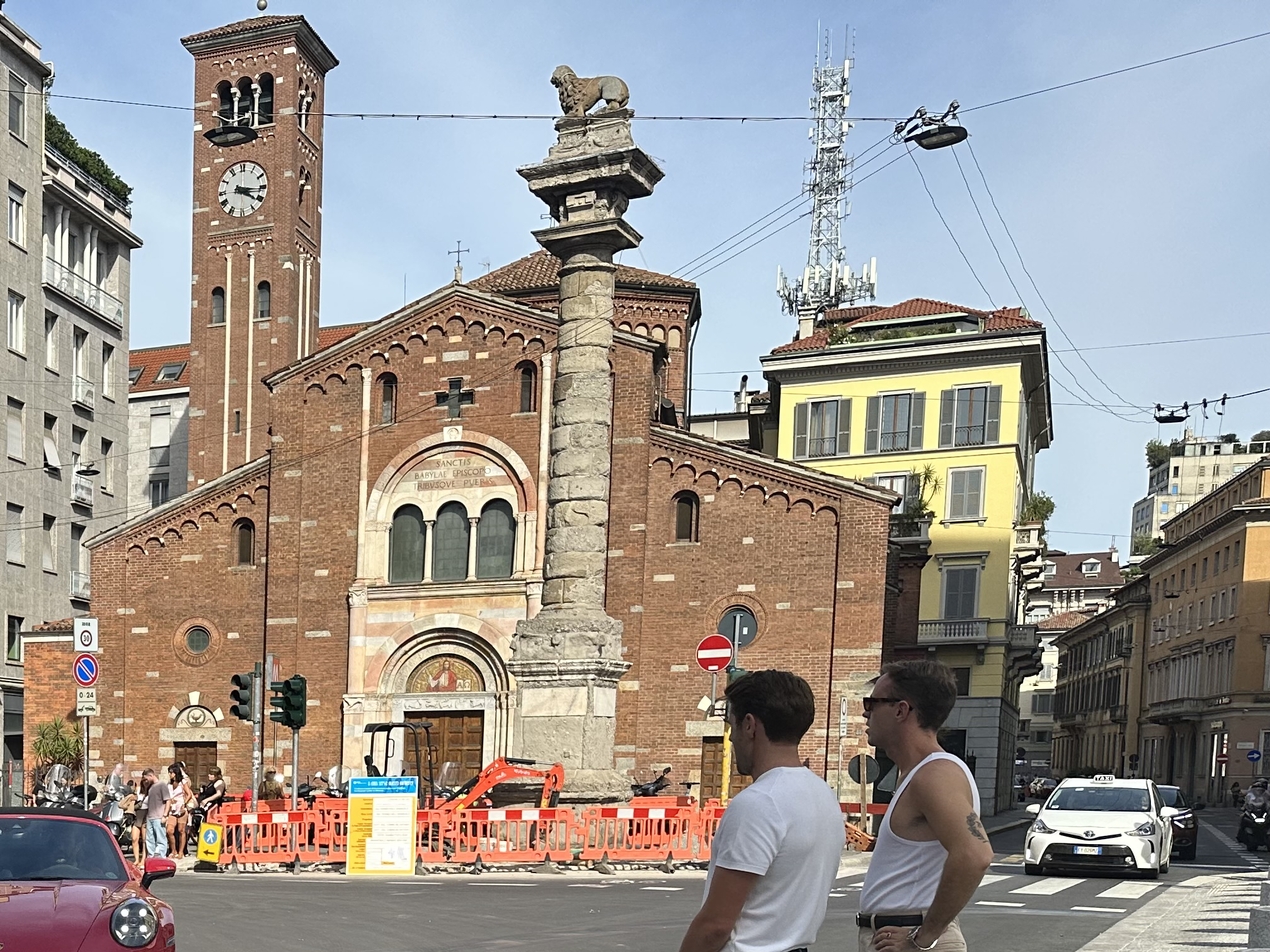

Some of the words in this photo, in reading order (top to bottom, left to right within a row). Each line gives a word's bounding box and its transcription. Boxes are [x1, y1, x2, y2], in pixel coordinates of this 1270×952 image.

[436, 459, 471, 467] SANCTIS
[414, 470, 447, 480] BABYLAE
[452, 467, 491, 477] EPISCOPO
